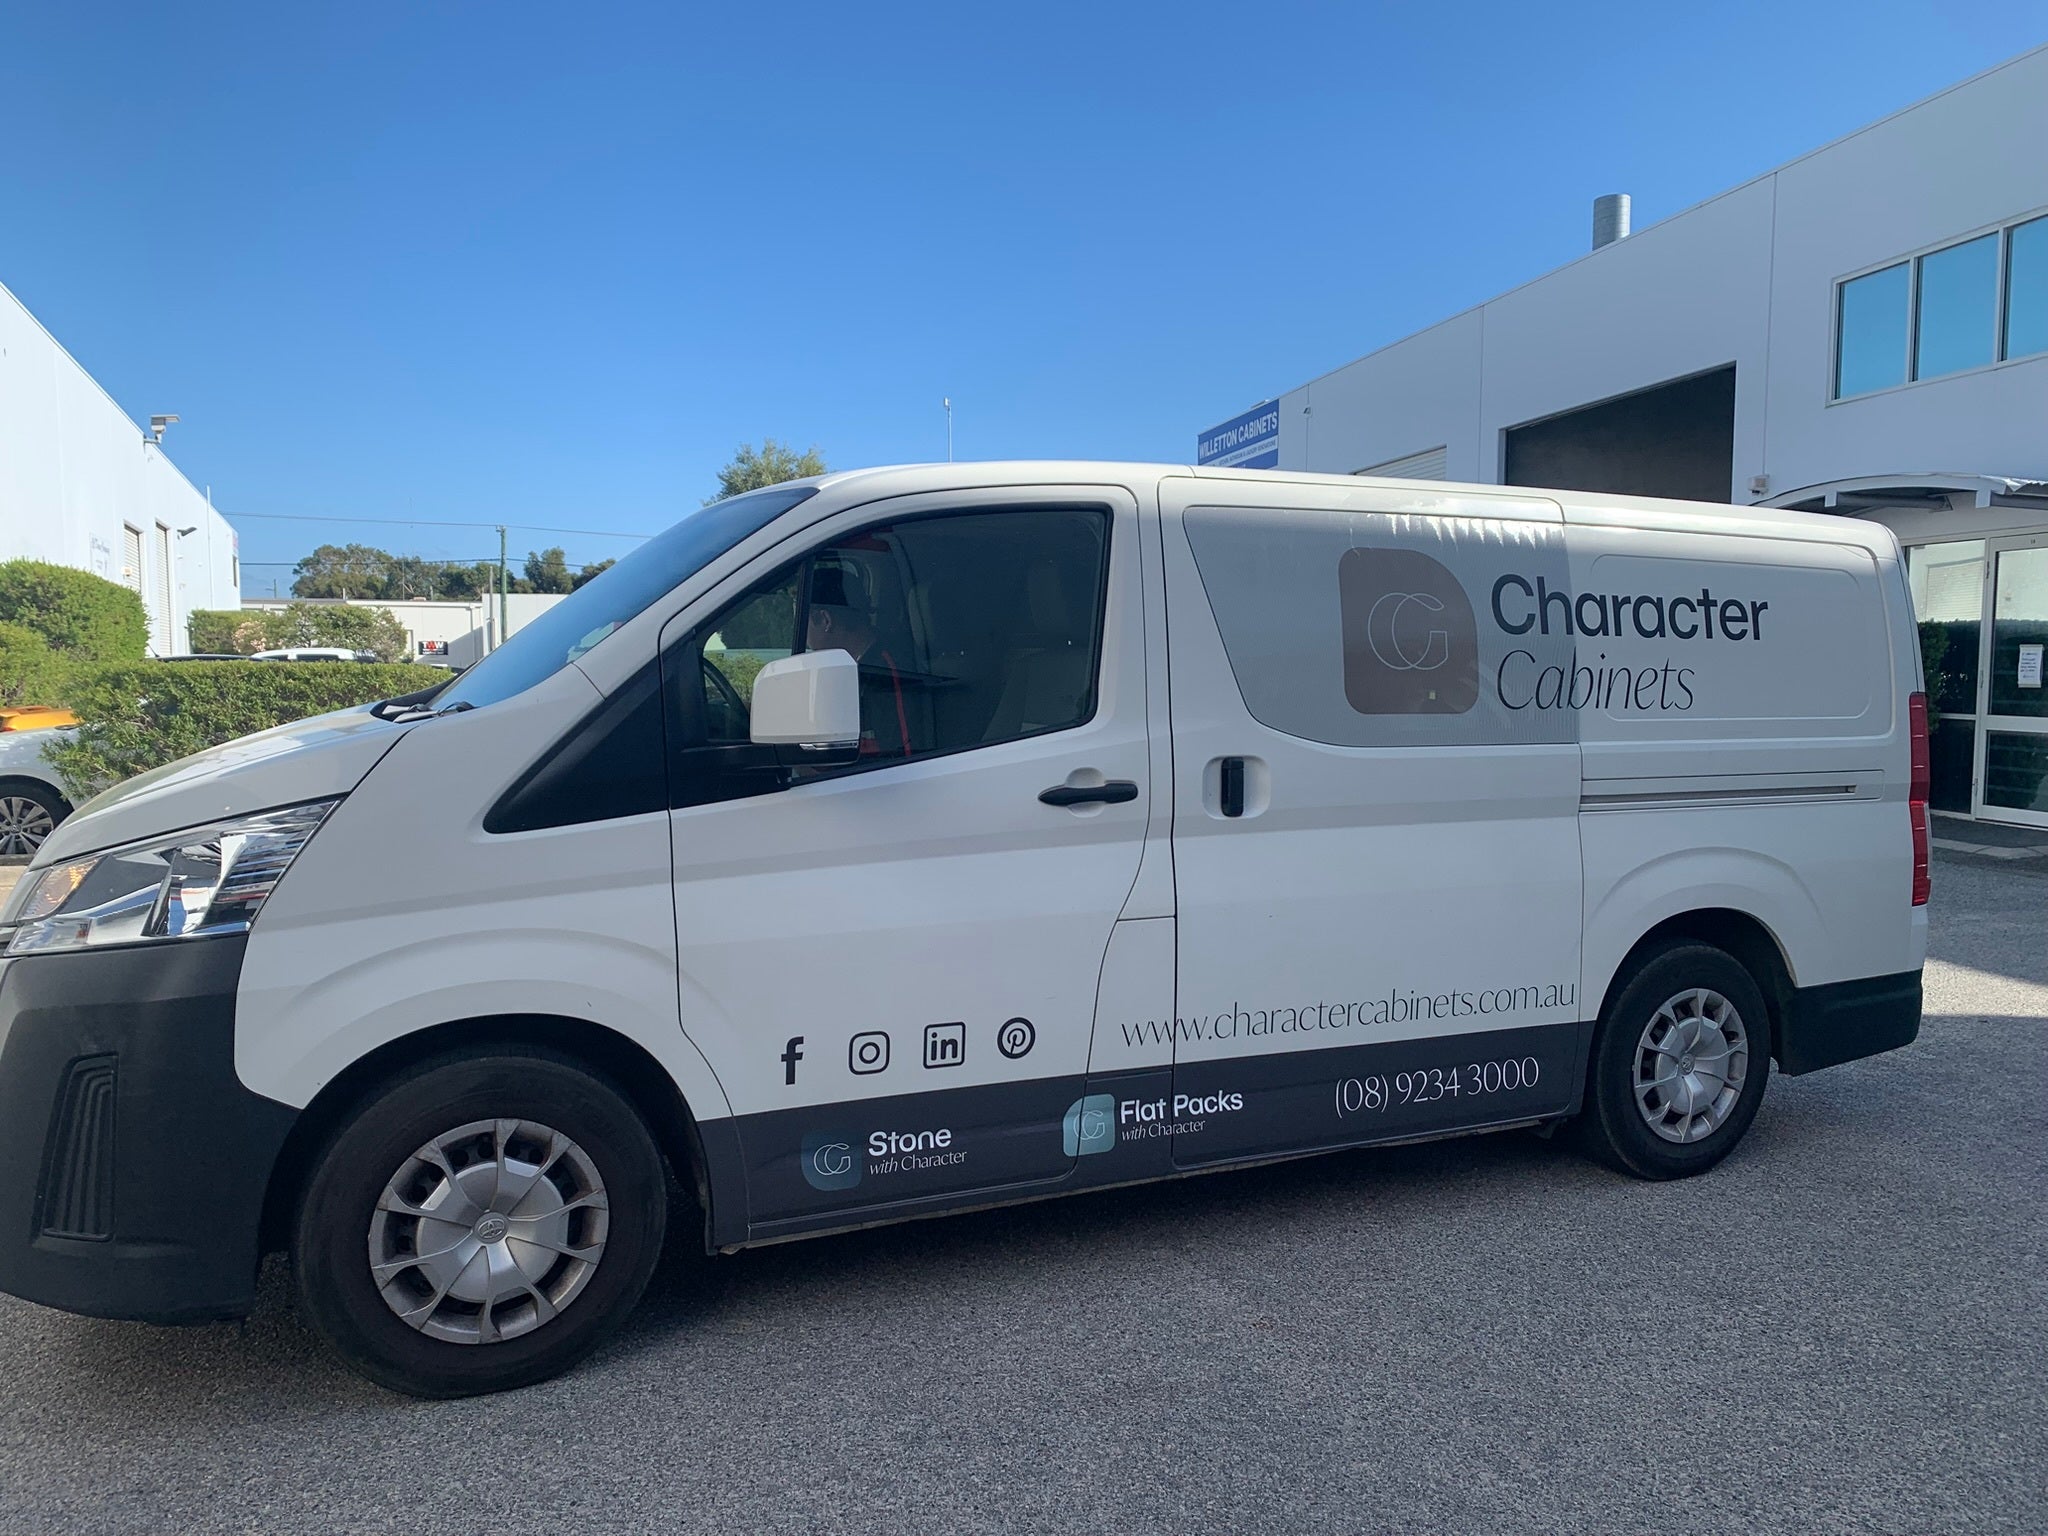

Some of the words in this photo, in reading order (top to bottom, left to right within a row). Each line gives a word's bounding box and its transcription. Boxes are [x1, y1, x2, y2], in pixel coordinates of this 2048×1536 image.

[1238, 411, 1277, 443] CABINETS
[1491, 573, 1768, 641] Character
[1496, 645, 1695, 710] Cabinets
[1121, 983, 1575, 1048] www.charactercabinets.com.au
[1335, 1074, 1389, 1118] (08)
[1395, 1067, 1461, 1104] 9234
[1467, 1057, 1539, 1095] 3000
[1120, 1098, 1166, 1124] Flat
[1173, 1090, 1243, 1117] Packs
[868, 1128, 952, 1157] Stone
[1121, 1126, 1146, 1141] with
[1148, 1119, 1205, 1138] Character
[869, 1159, 898, 1175] with
[901, 1151, 967, 1171] Character
